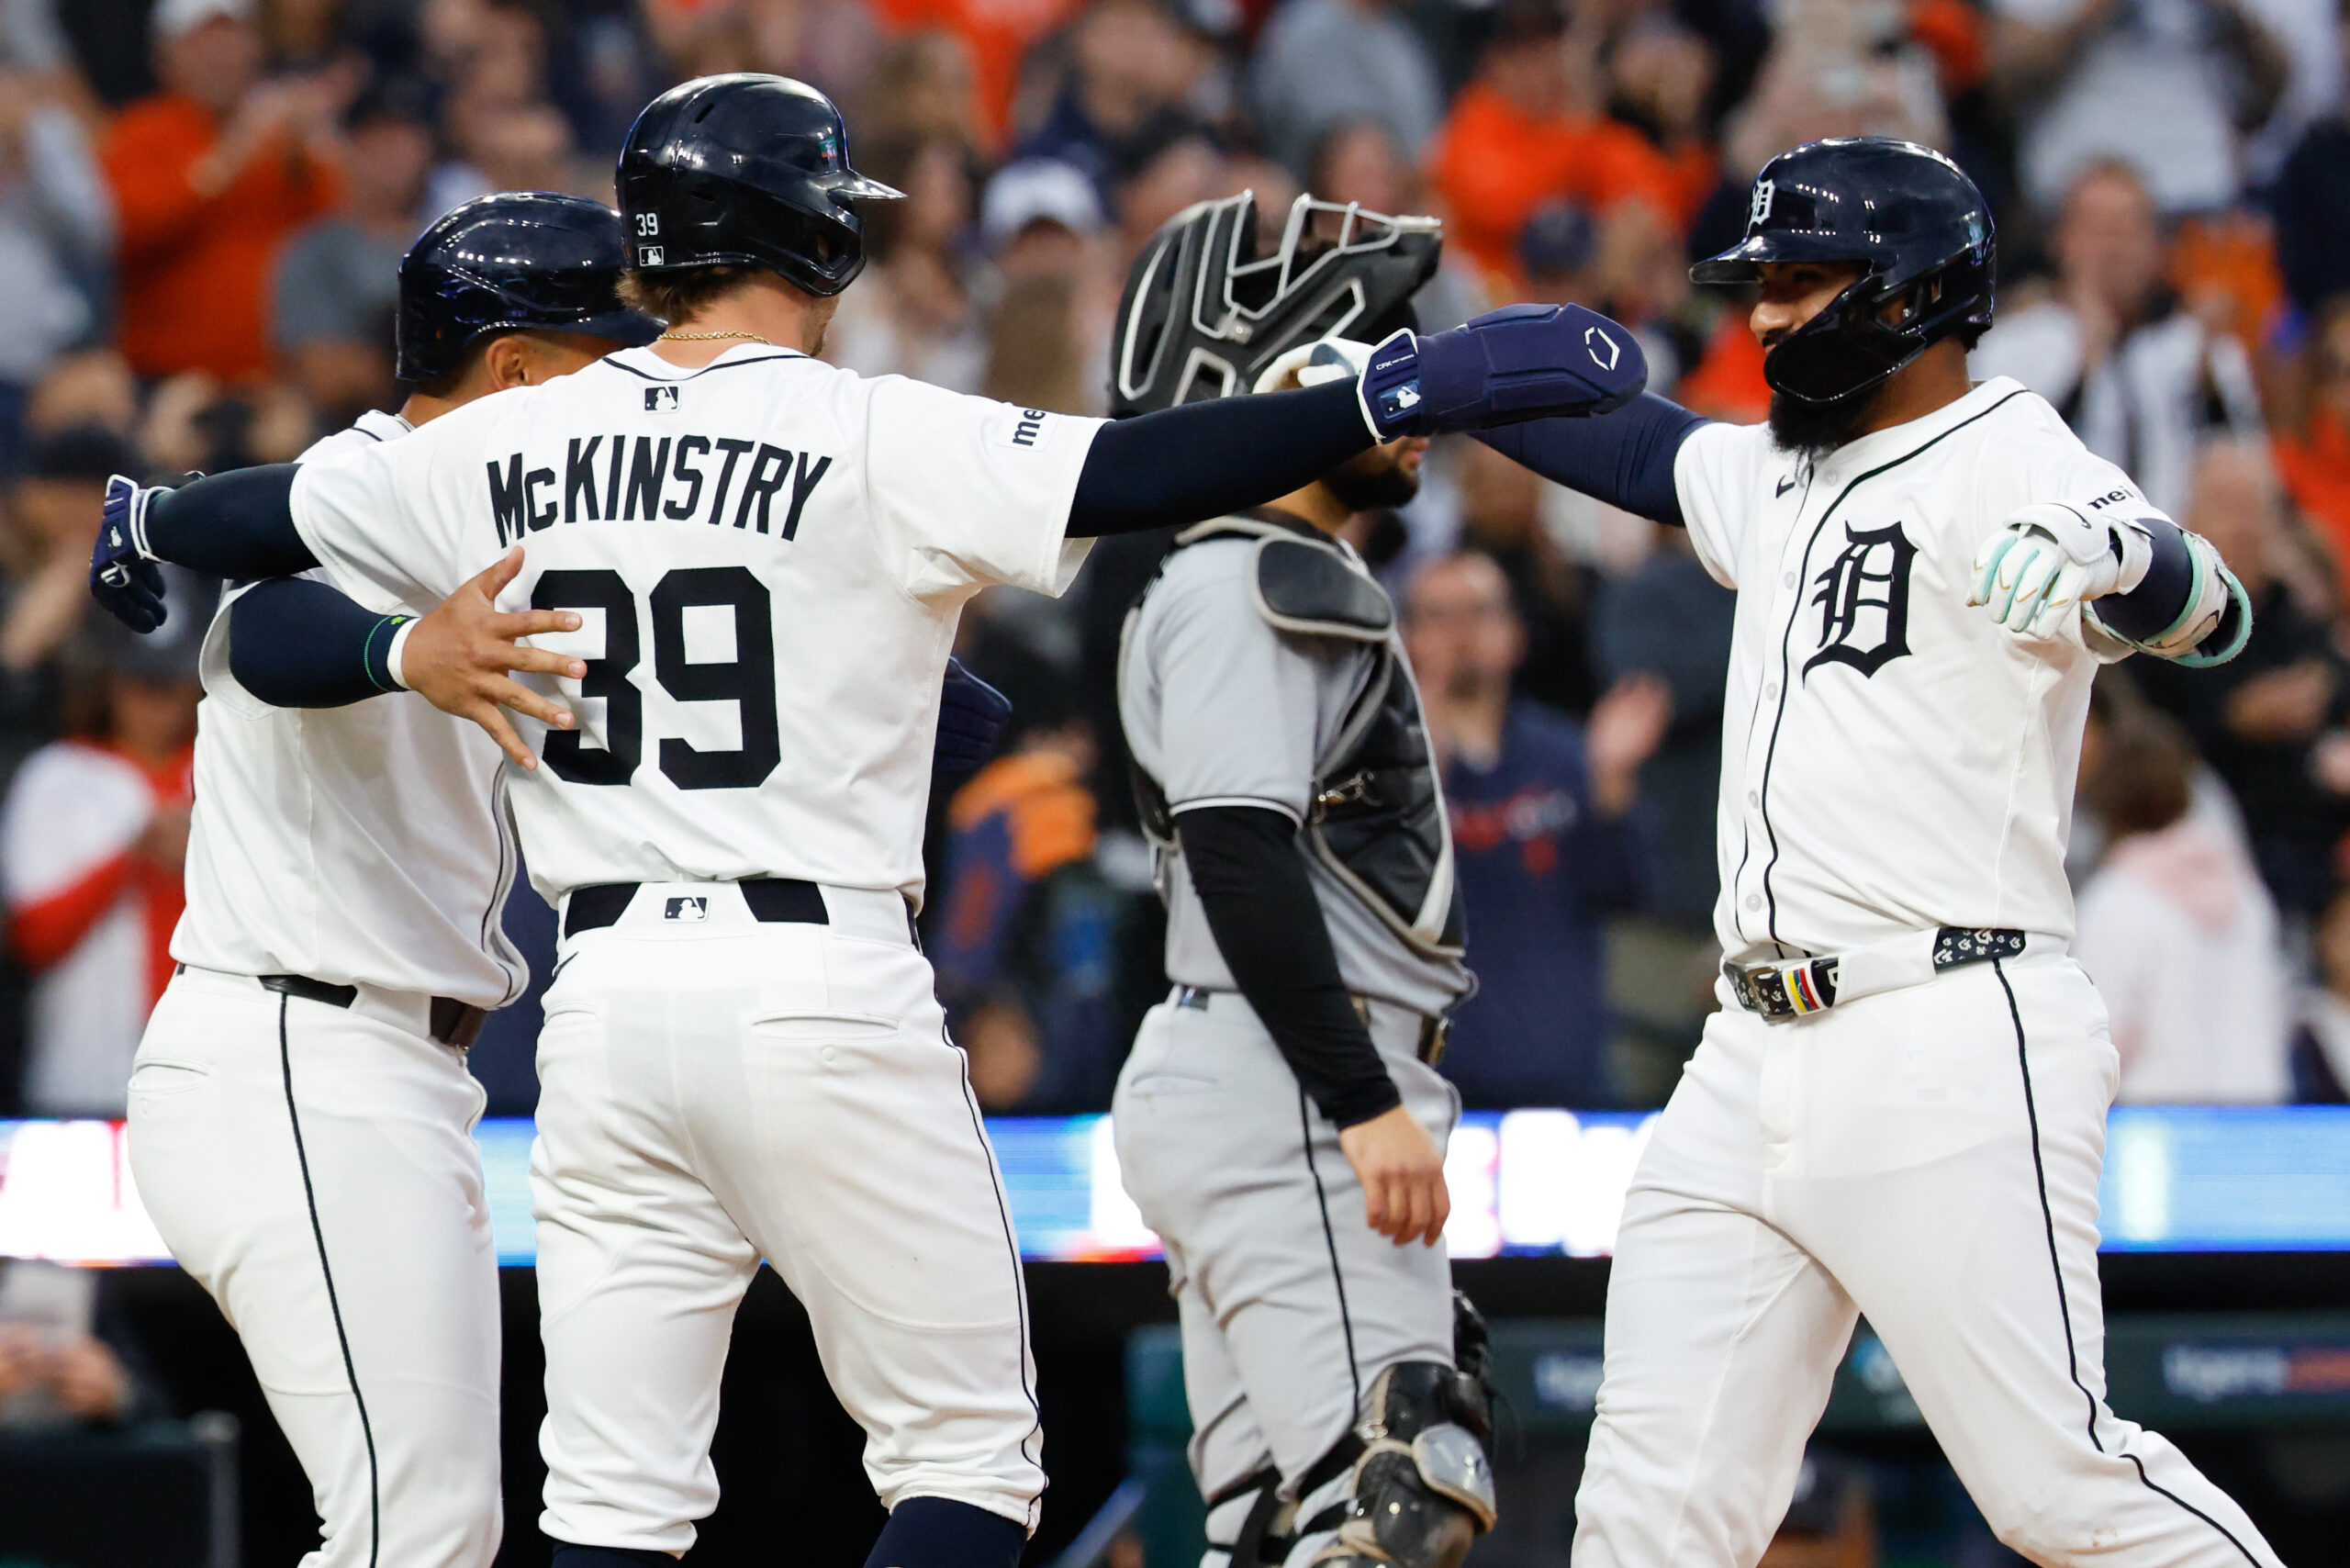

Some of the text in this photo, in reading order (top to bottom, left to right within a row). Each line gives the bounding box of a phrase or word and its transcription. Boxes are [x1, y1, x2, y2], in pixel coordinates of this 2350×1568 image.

[636, 213, 658, 236] 39
[487, 434, 834, 549] McKINSTRY
[1802, 520, 1919, 689] D
[530, 566, 781, 790] 39
